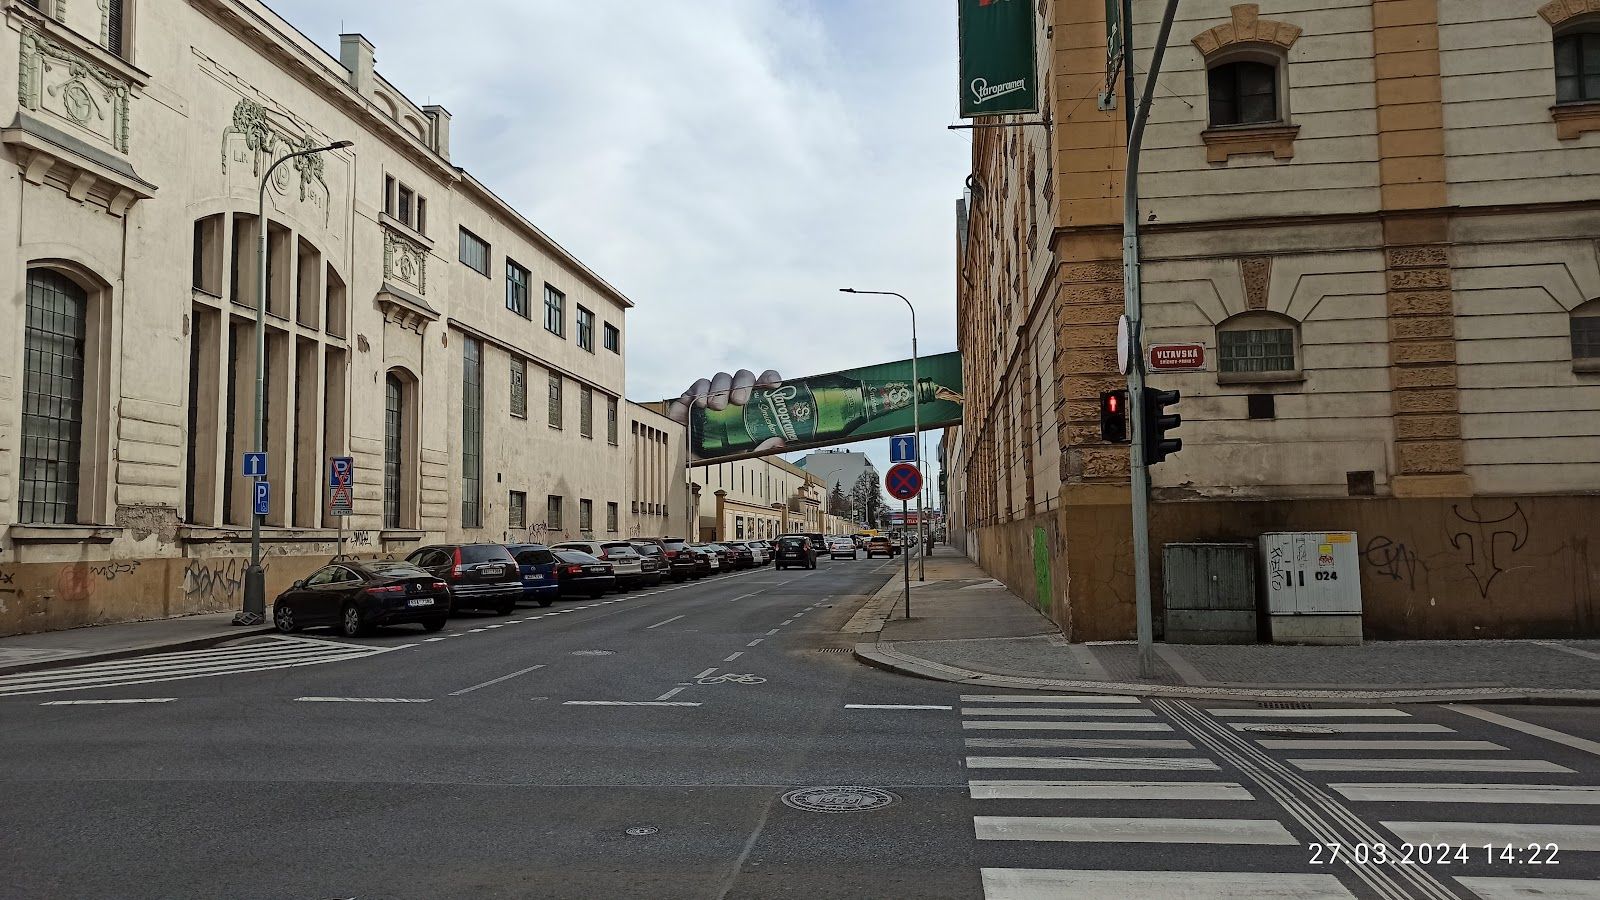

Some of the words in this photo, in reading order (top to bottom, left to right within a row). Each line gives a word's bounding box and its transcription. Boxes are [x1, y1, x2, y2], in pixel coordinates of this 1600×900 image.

[970, 77, 1027, 104] Staropramen
[1157, 349, 1198, 358] VLTAVSKÁ
[1314, 571, 1338, 581] 024
